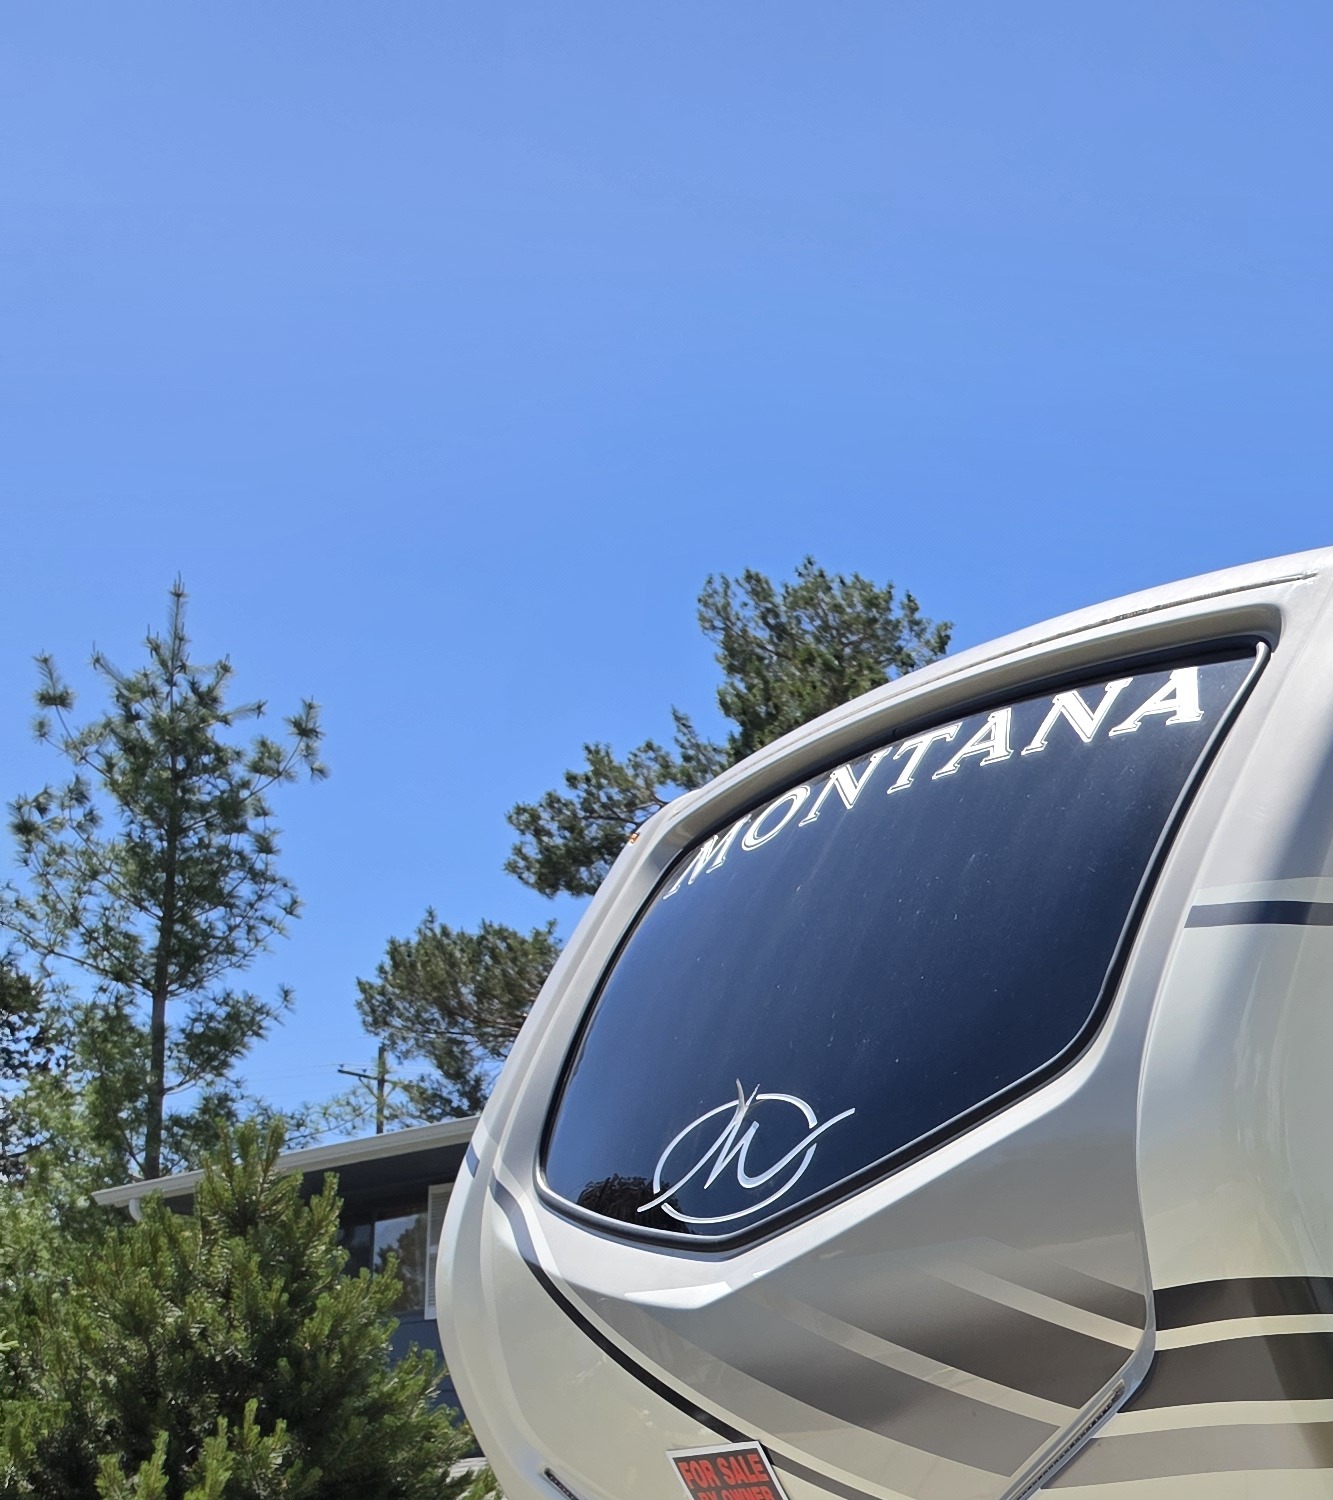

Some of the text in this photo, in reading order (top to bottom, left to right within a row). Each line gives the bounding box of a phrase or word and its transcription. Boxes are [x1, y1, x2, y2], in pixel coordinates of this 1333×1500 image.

[662, 666, 1205, 900] MONTANA
[677, 1454, 769, 1489] FOR SALE
